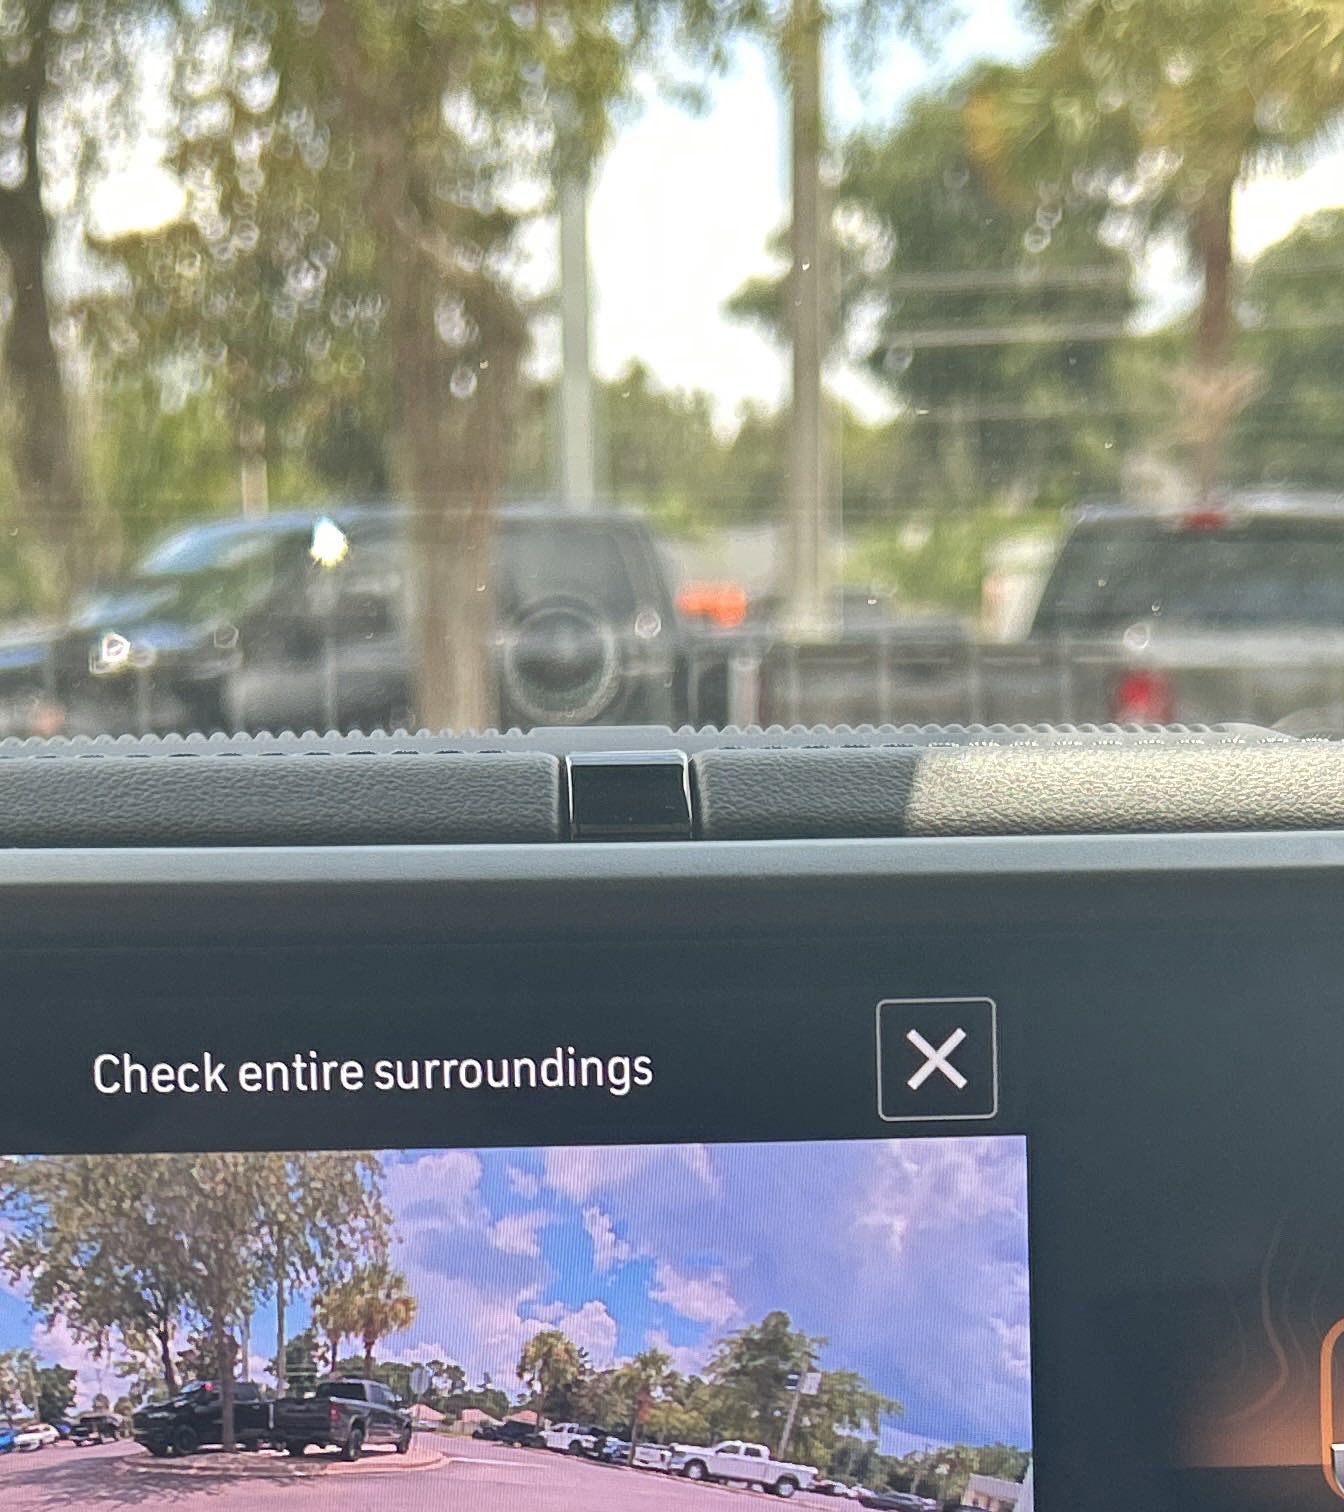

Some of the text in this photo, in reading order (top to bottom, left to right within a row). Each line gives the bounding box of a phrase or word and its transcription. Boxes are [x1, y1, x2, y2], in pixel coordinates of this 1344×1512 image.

[92, 1046, 655, 1098] Check entire surroundings
